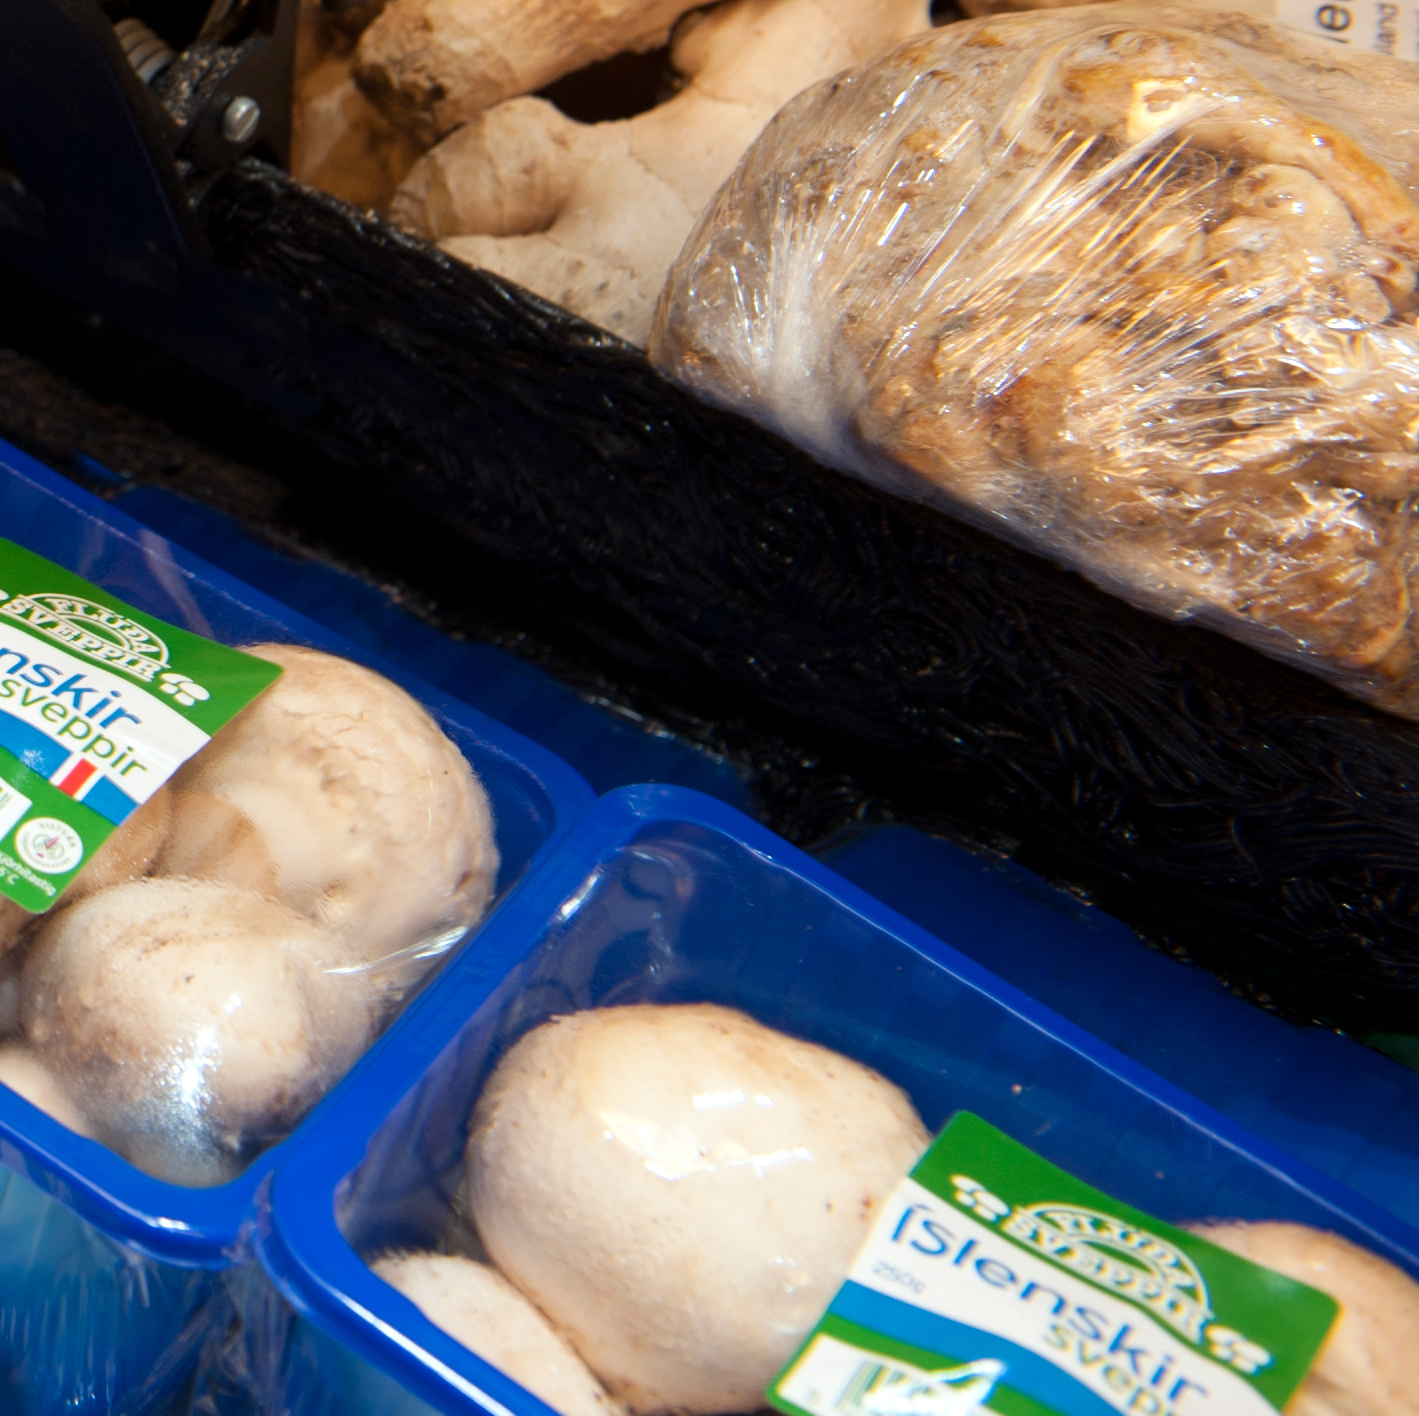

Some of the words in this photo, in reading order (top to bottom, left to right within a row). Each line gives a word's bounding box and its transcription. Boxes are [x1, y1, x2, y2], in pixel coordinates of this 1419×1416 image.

[1372, 3, 1400, 55] land
[0, 597, 163, 679] SVEPPIR
[890, 1203, 1210, 1402] íslenskir
[1042, 1321, 1176, 1416] svep
